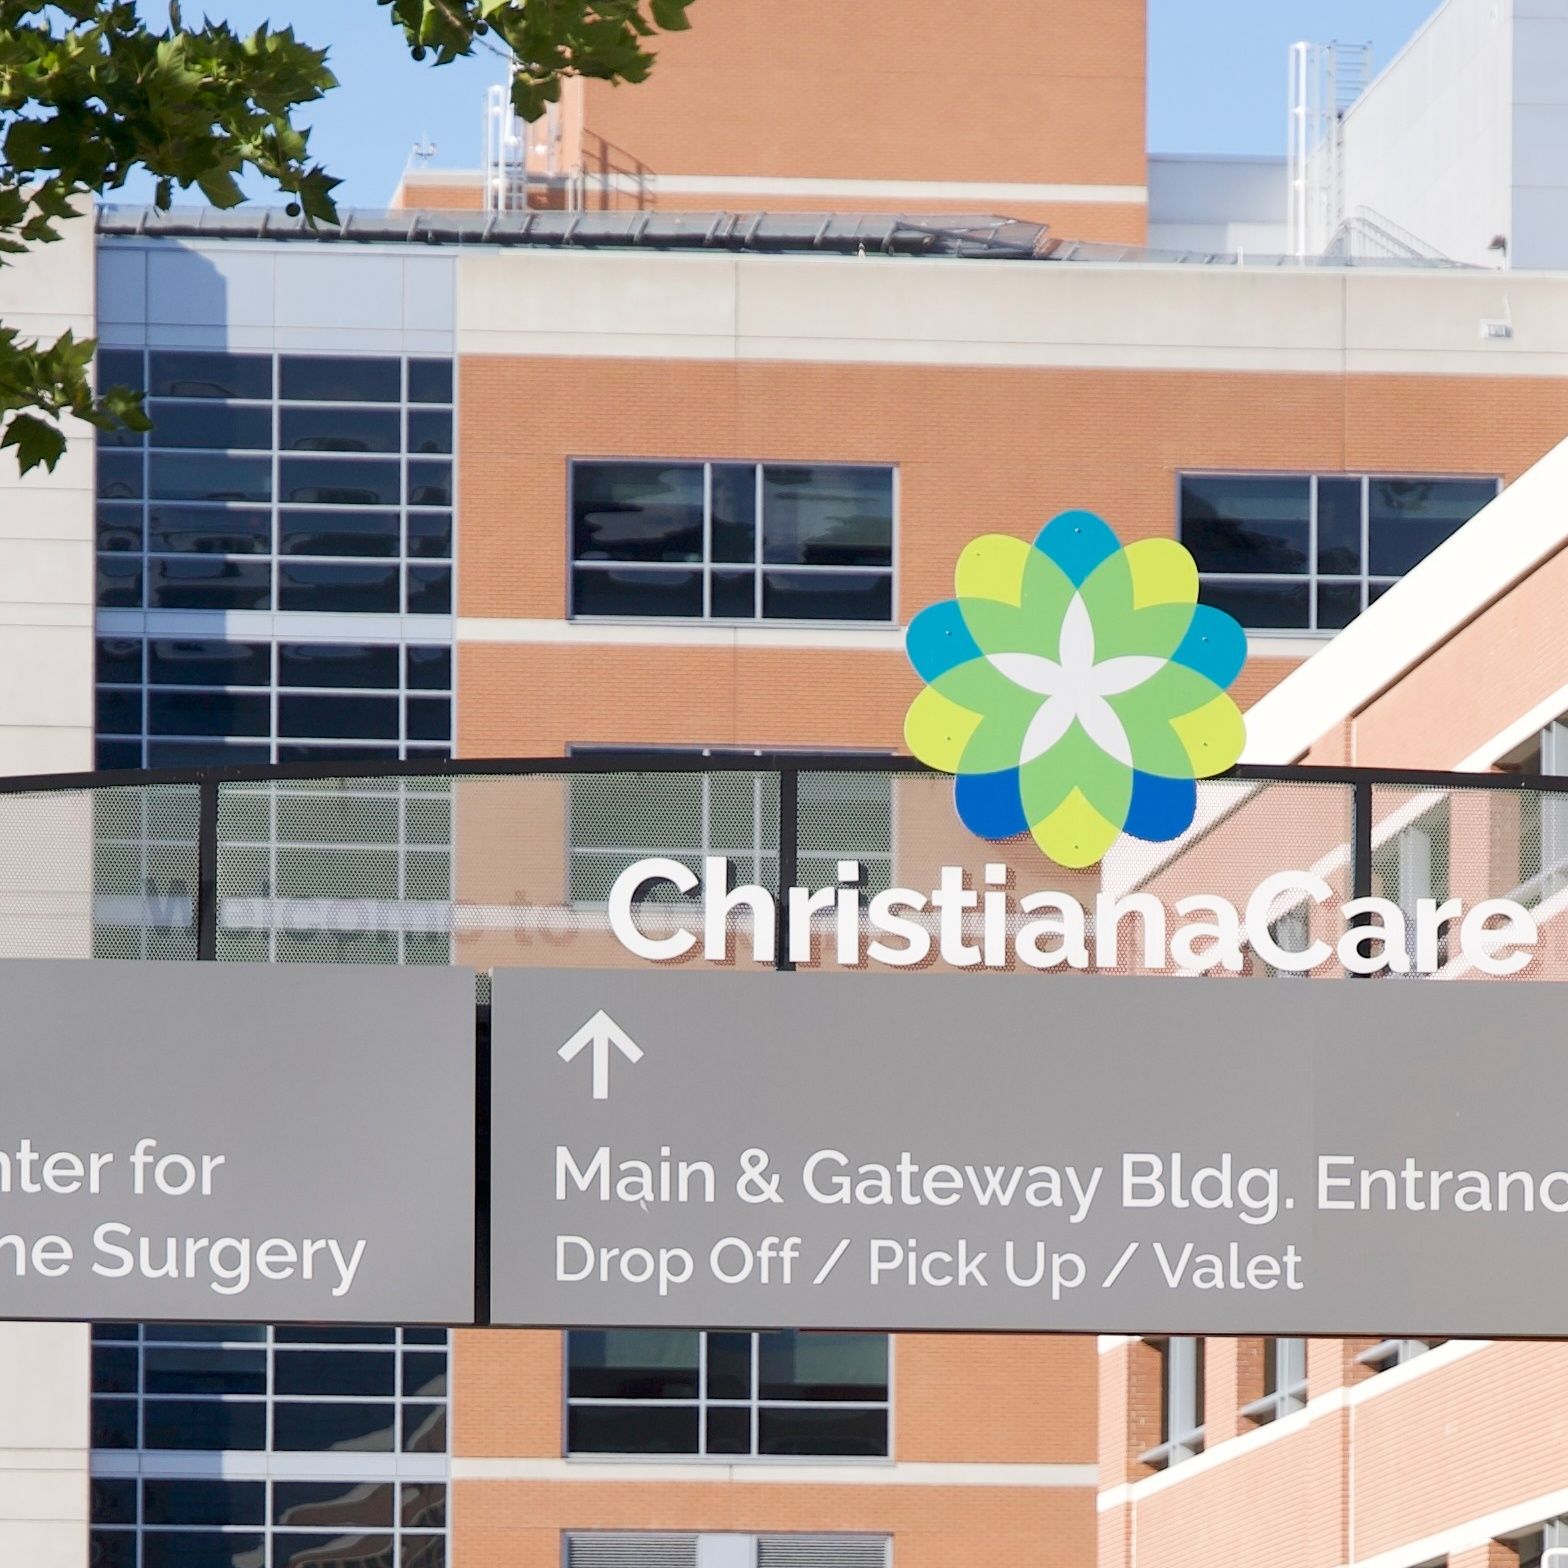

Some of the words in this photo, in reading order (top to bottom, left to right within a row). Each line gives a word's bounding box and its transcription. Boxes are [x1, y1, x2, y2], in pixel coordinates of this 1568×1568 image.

[607, 855, 1539, 977] ChristianaCare
[128, 1137, 226, 1197] for
[555, 1145, 716, 1203] Main
[735, 1147, 785, 1204] &
[801, 1148, 1104, 1225] Gateway
[1121, 1151, 1295, 1226] Bldg.
[90, 1221, 368, 1298] Surgery
[555, 1234, 695, 1297] Drop
[709, 1235, 803, 1285] Off
[869, 1237, 989, 1287] Pick
[1004, 1240, 1087, 1301] Up
[1151, 1241, 1305, 1291] Valet
